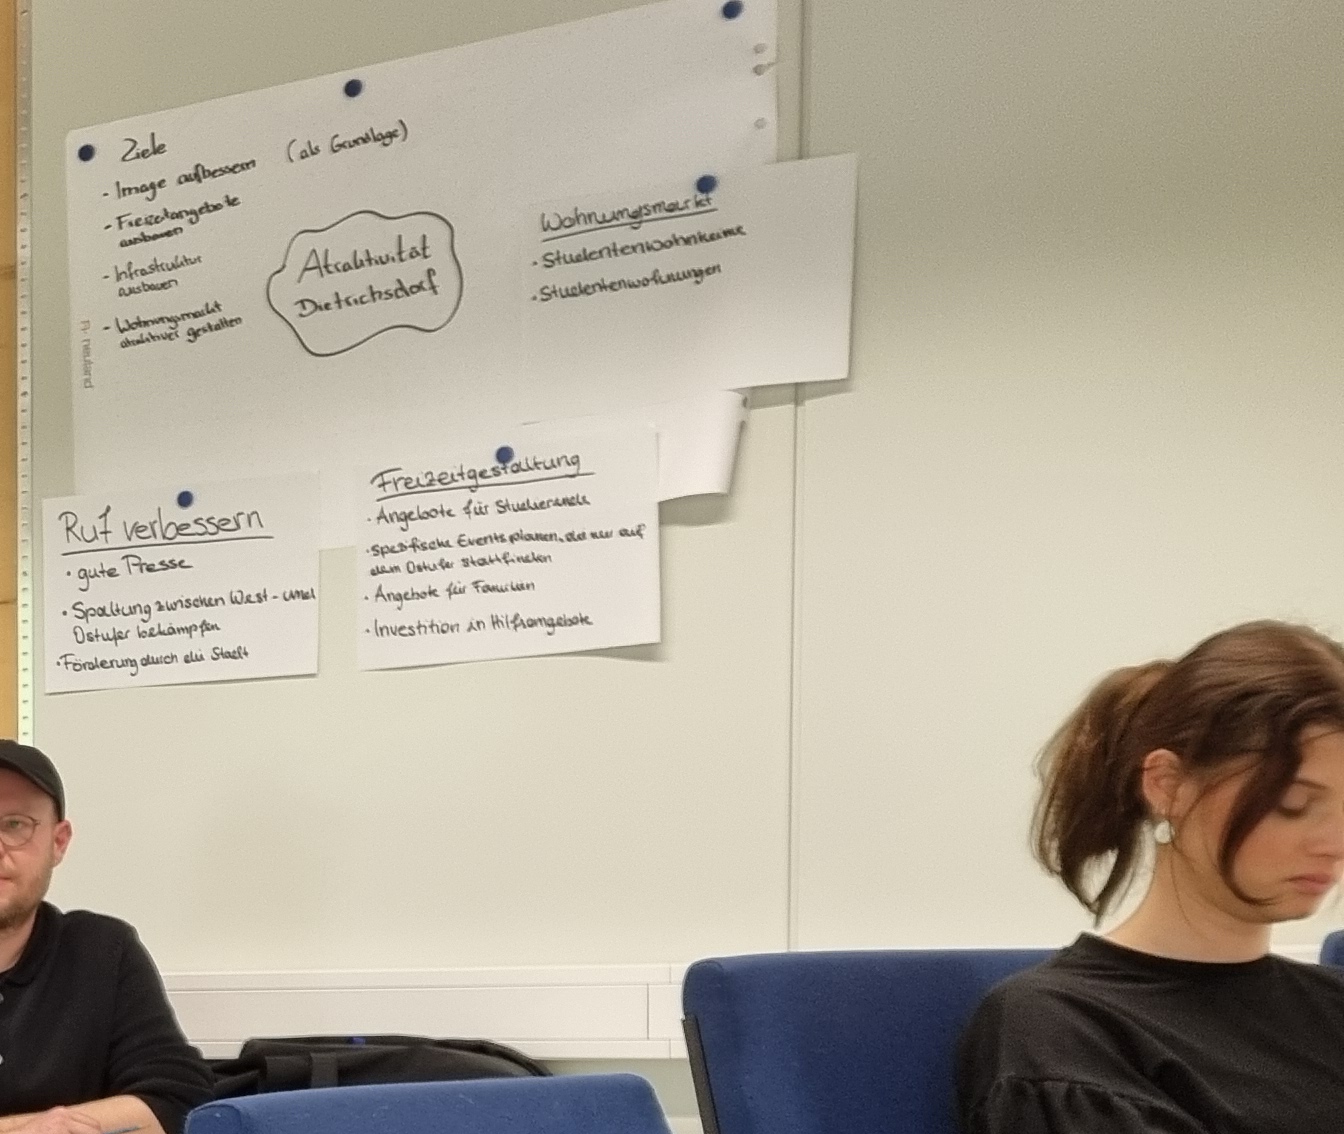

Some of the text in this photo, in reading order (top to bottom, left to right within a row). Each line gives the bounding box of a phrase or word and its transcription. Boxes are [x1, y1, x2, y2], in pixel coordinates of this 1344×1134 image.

[121, 132, 167, 162] Ziele
[116, 159, 256, 202] Image aufbessern
[541, 194, 713, 232] Wohnungsmarkt
[114, 255, 203, 282] Infrastruktur
[540, 263, 721, 301] Studentenwohnungen
[118, 278, 179, 298] ausbauen
[294, 267, 439, 317] Dietrichsdorf
[186, 316, 243, 343] gestalten
[371, 453, 581, 492] Freizeitgestaltung
[58, 505, 264, 544] Ruf verbessern
[376, 504, 456, 532] Angebote
[463, 498, 490, 519] für
[618, 523, 647, 540] auf
[77, 554, 194, 591] gute Presse
[406, 558, 455, 575] Ostufer
[72, 600, 152, 623] Spaltung
[156, 595, 226, 612] zwischen
[374, 583, 440, 611] Angebote
[446, 580, 468, 600] für
[73, 620, 221, 646] Ostufer bekämpfen
[374, 618, 460, 638] Investition
[466, 619, 486, 633] in
[60, 652, 139, 676] Förderung
[140, 652, 178, 667] durch
